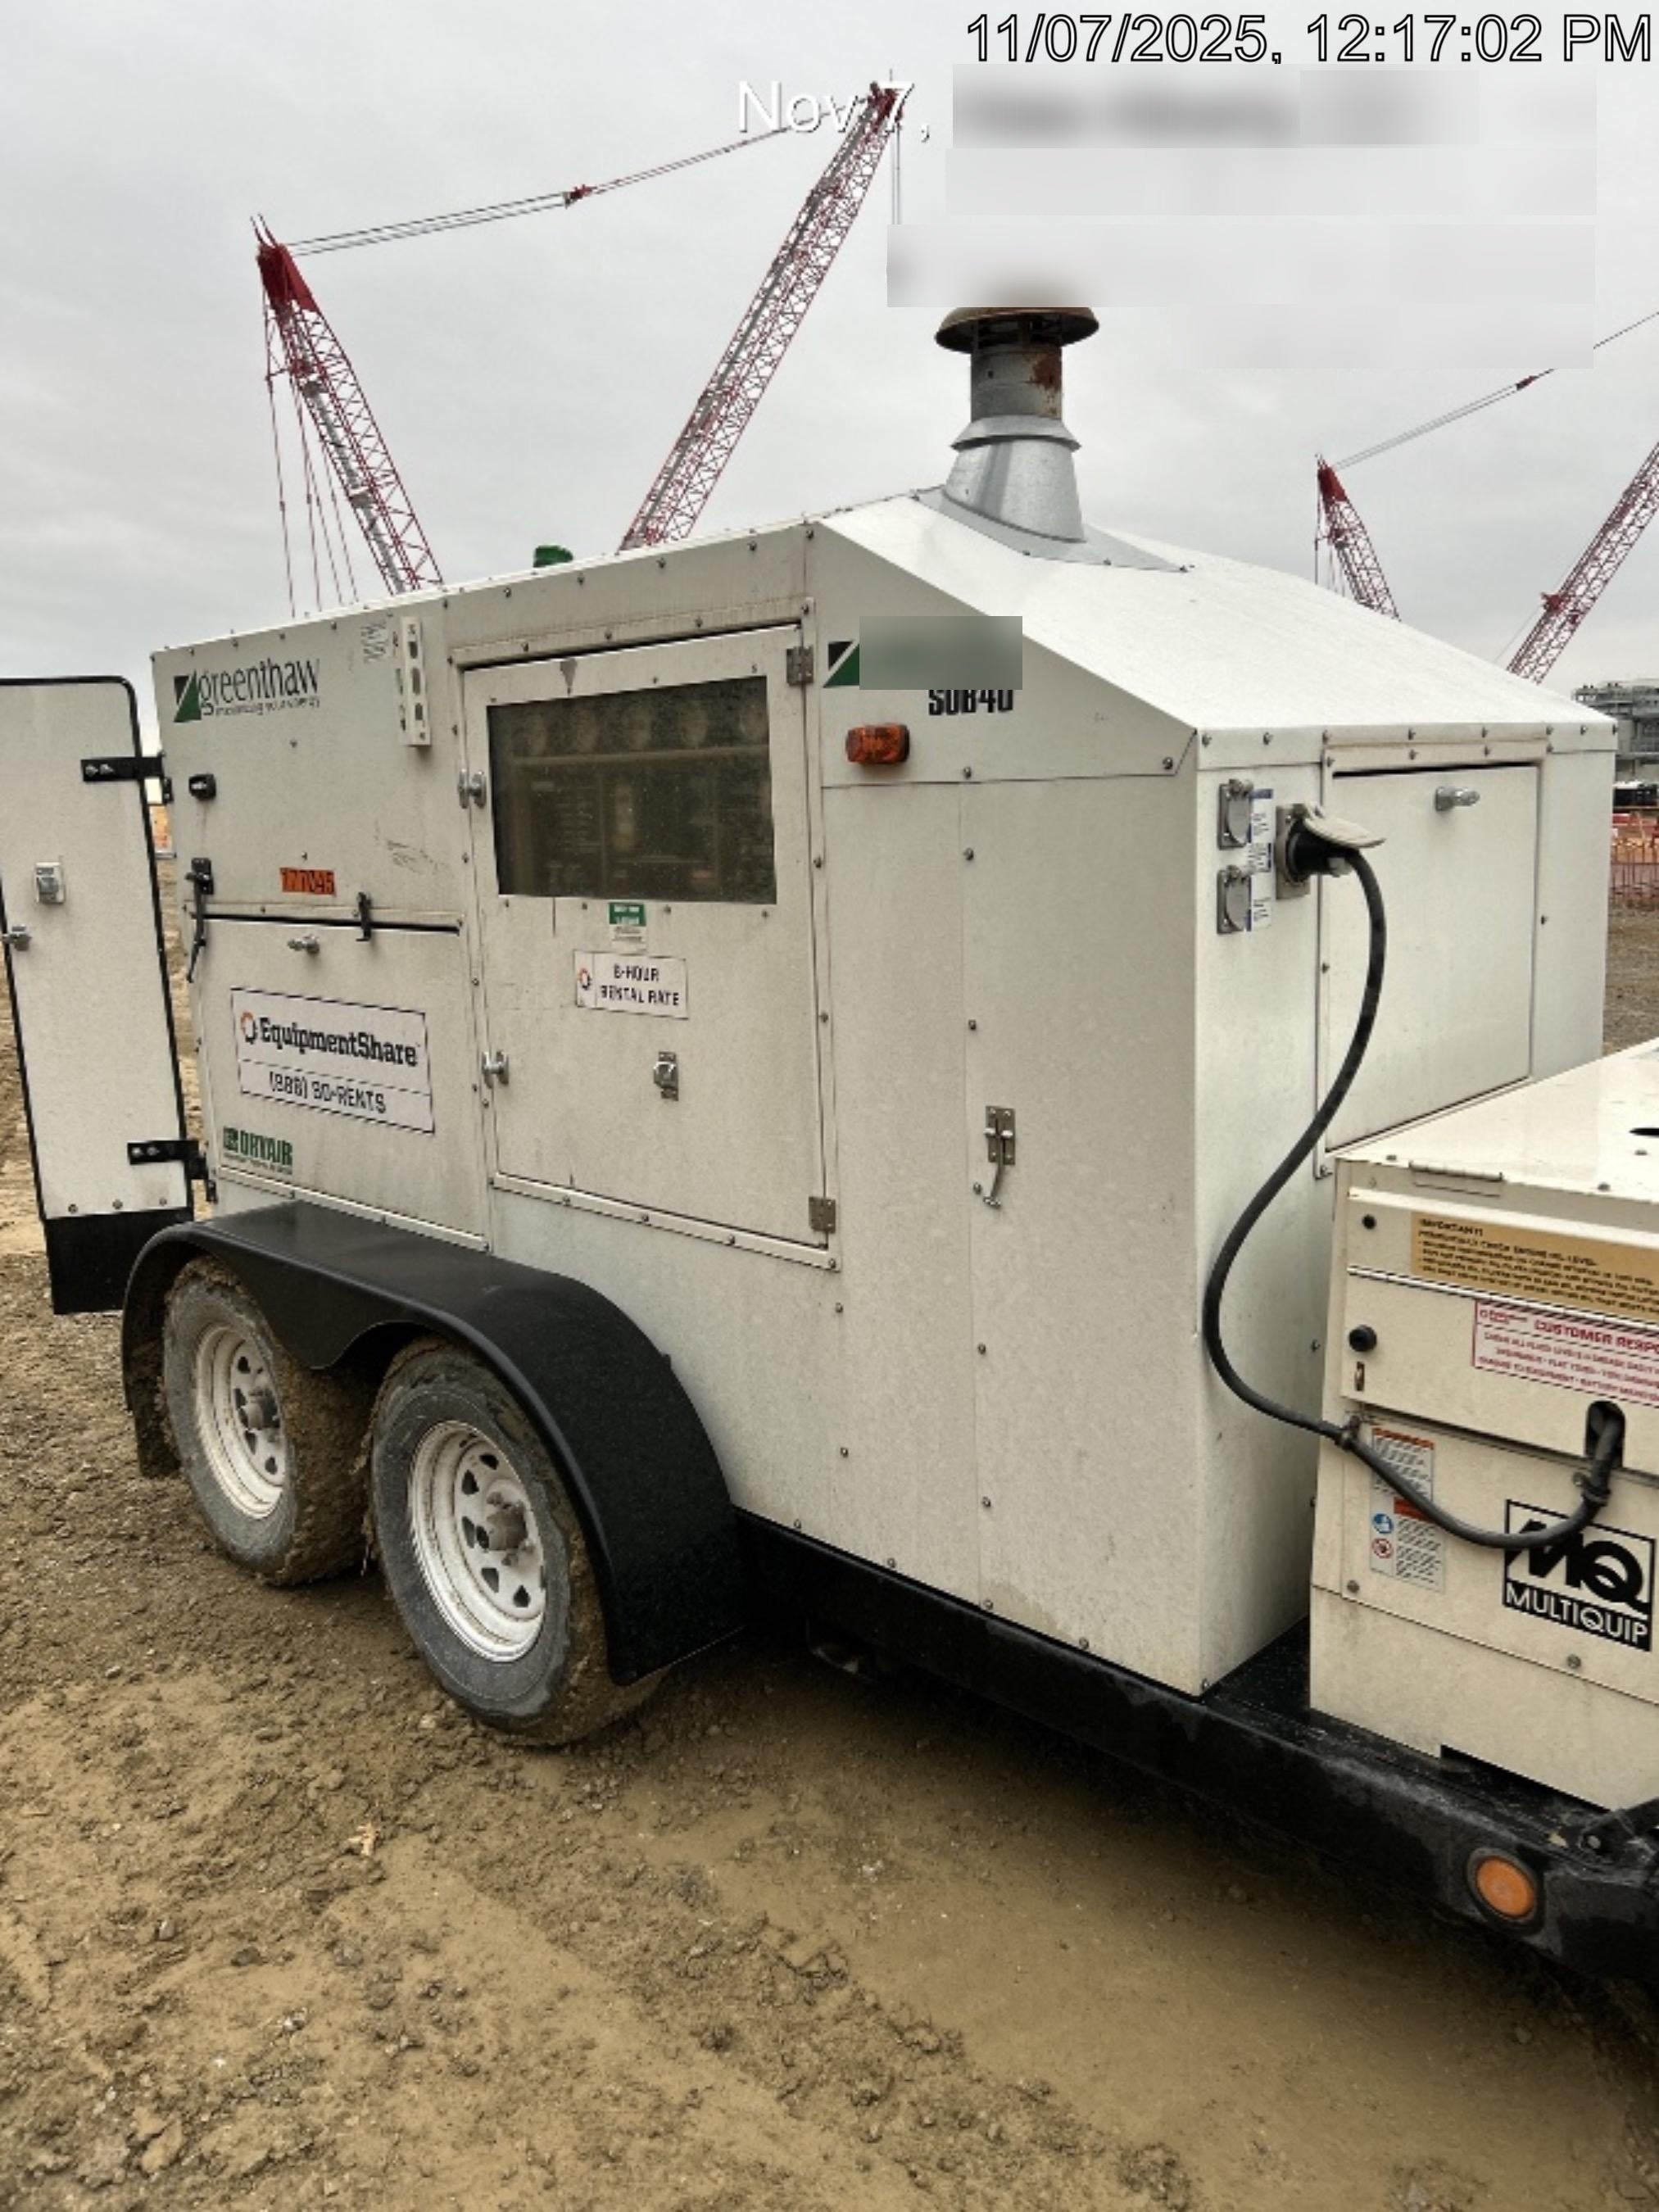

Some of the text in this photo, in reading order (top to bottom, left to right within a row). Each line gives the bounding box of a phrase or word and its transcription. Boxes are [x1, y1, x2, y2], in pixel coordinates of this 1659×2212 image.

[198, 657, 320, 716] greenthaw
[648, 990, 679, 1006] RATE
[260, 1017, 419, 1067] EquipmentShare
[240, 1130, 293, 1166] DRYAIR
[1534, 1319, 1613, 1346] CUSTOMER
[1506, 1581, 1648, 1645] MULTIQUIP
